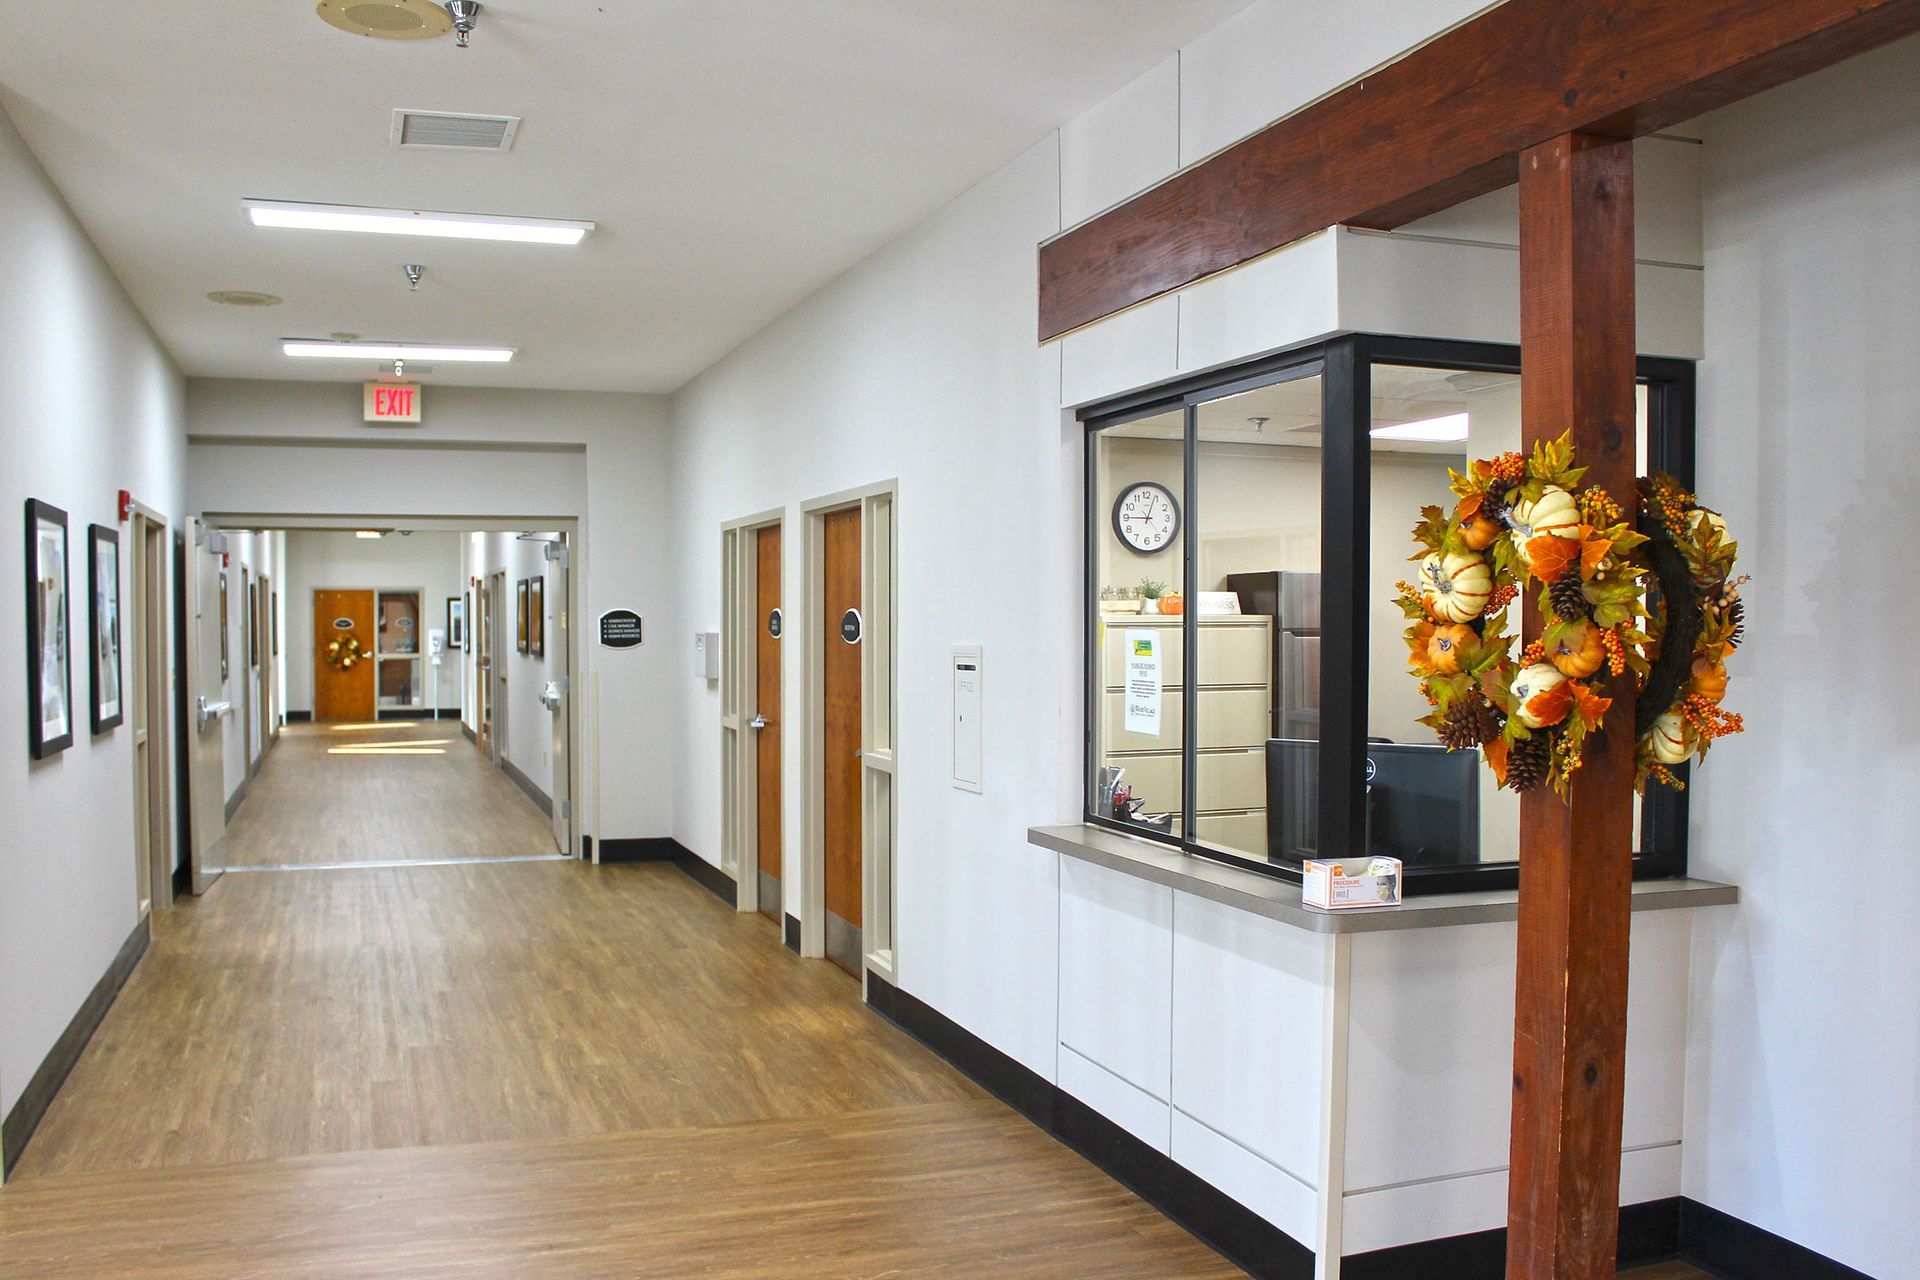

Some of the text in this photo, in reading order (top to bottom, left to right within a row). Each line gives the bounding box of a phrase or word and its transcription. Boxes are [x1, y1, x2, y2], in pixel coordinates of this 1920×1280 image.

[374, 388, 414, 416] EXIT
[1134, 494, 1140, 502] 11
[1142, 491, 1151, 499] 12
[1125, 503, 1135, 511] 10
[1123, 513, 1129, 522] 9
[1164, 514, 1171, 522] 3
[1134, 534, 1139, 542] 7
[1143, 537, 1151, 545] 6
[1154, 534, 1161, 542] 5
